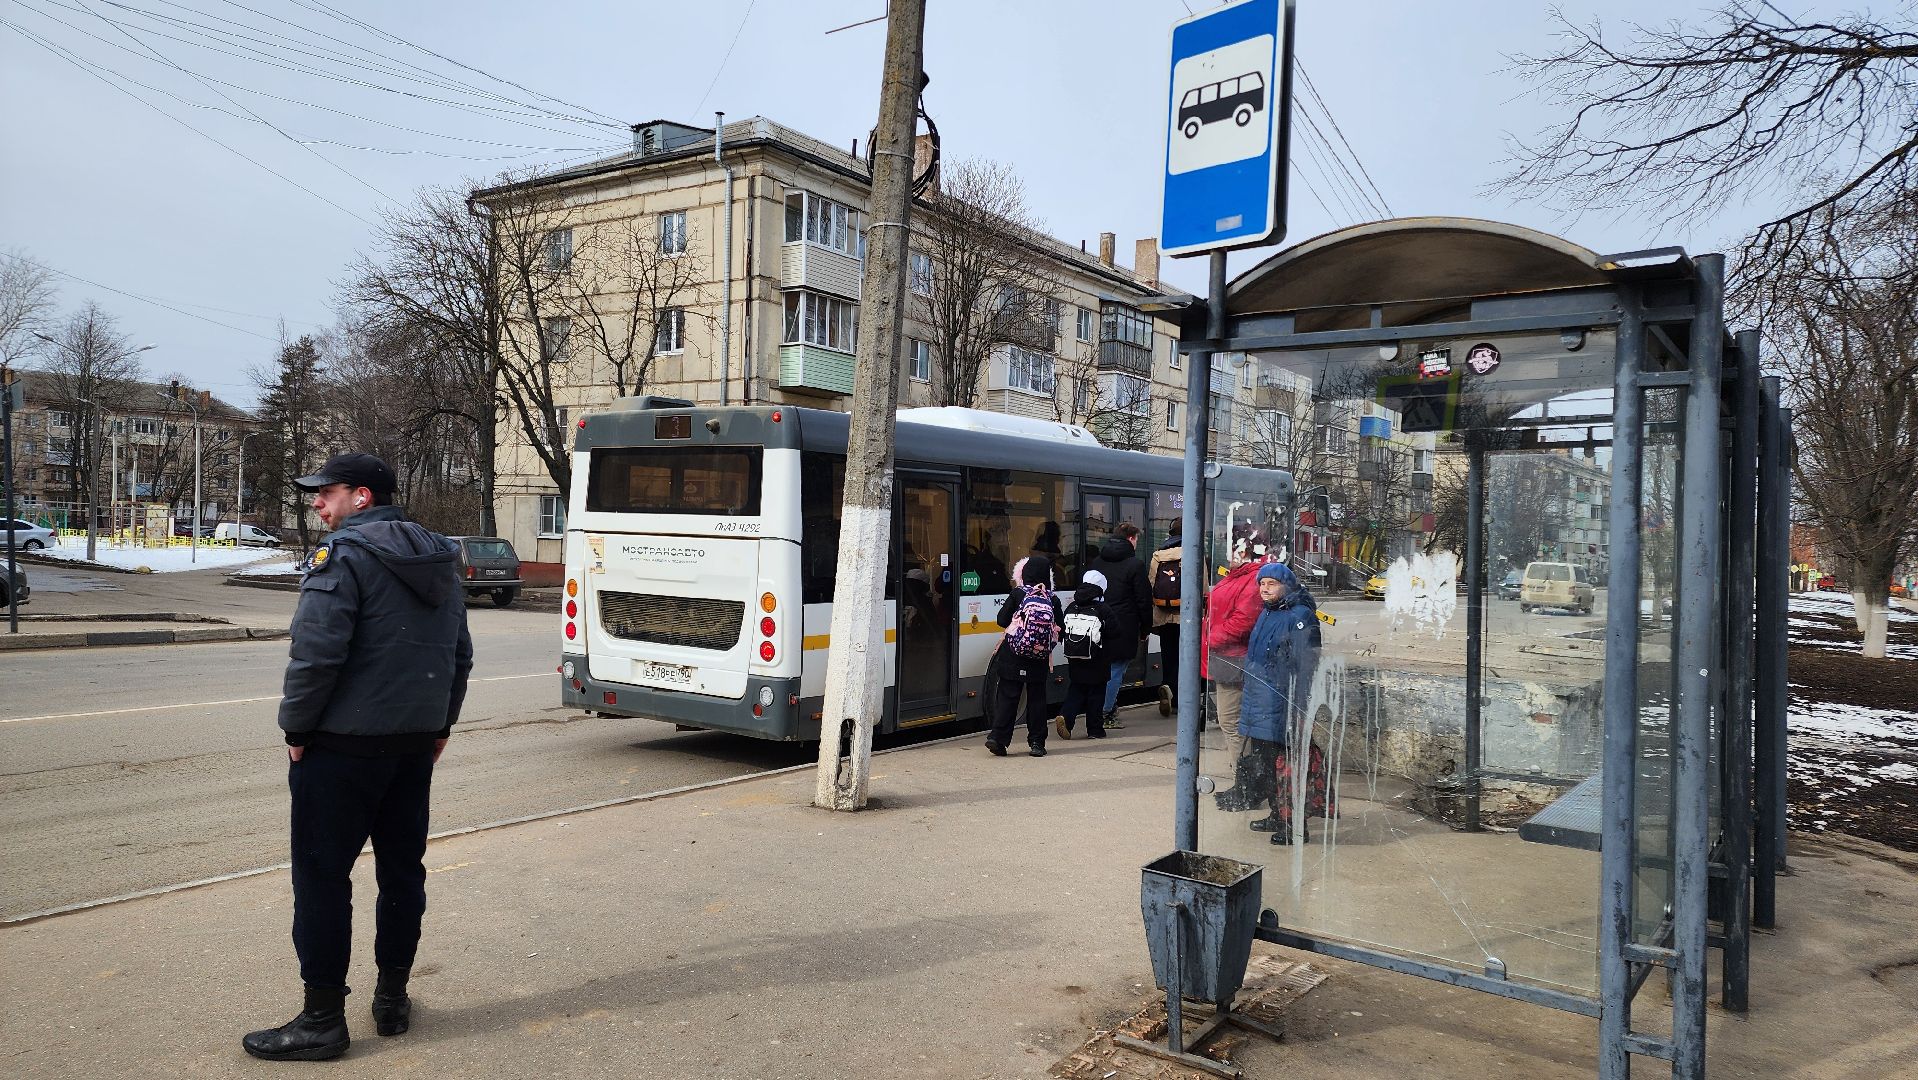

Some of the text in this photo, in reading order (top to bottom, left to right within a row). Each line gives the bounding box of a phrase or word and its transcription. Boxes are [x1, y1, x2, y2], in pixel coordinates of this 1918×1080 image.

[739, 523, 761, 533] 4292
[622, 545, 706, 558] МОСТРАНСАВТО
[963, 577, 978, 587] ВХОД
